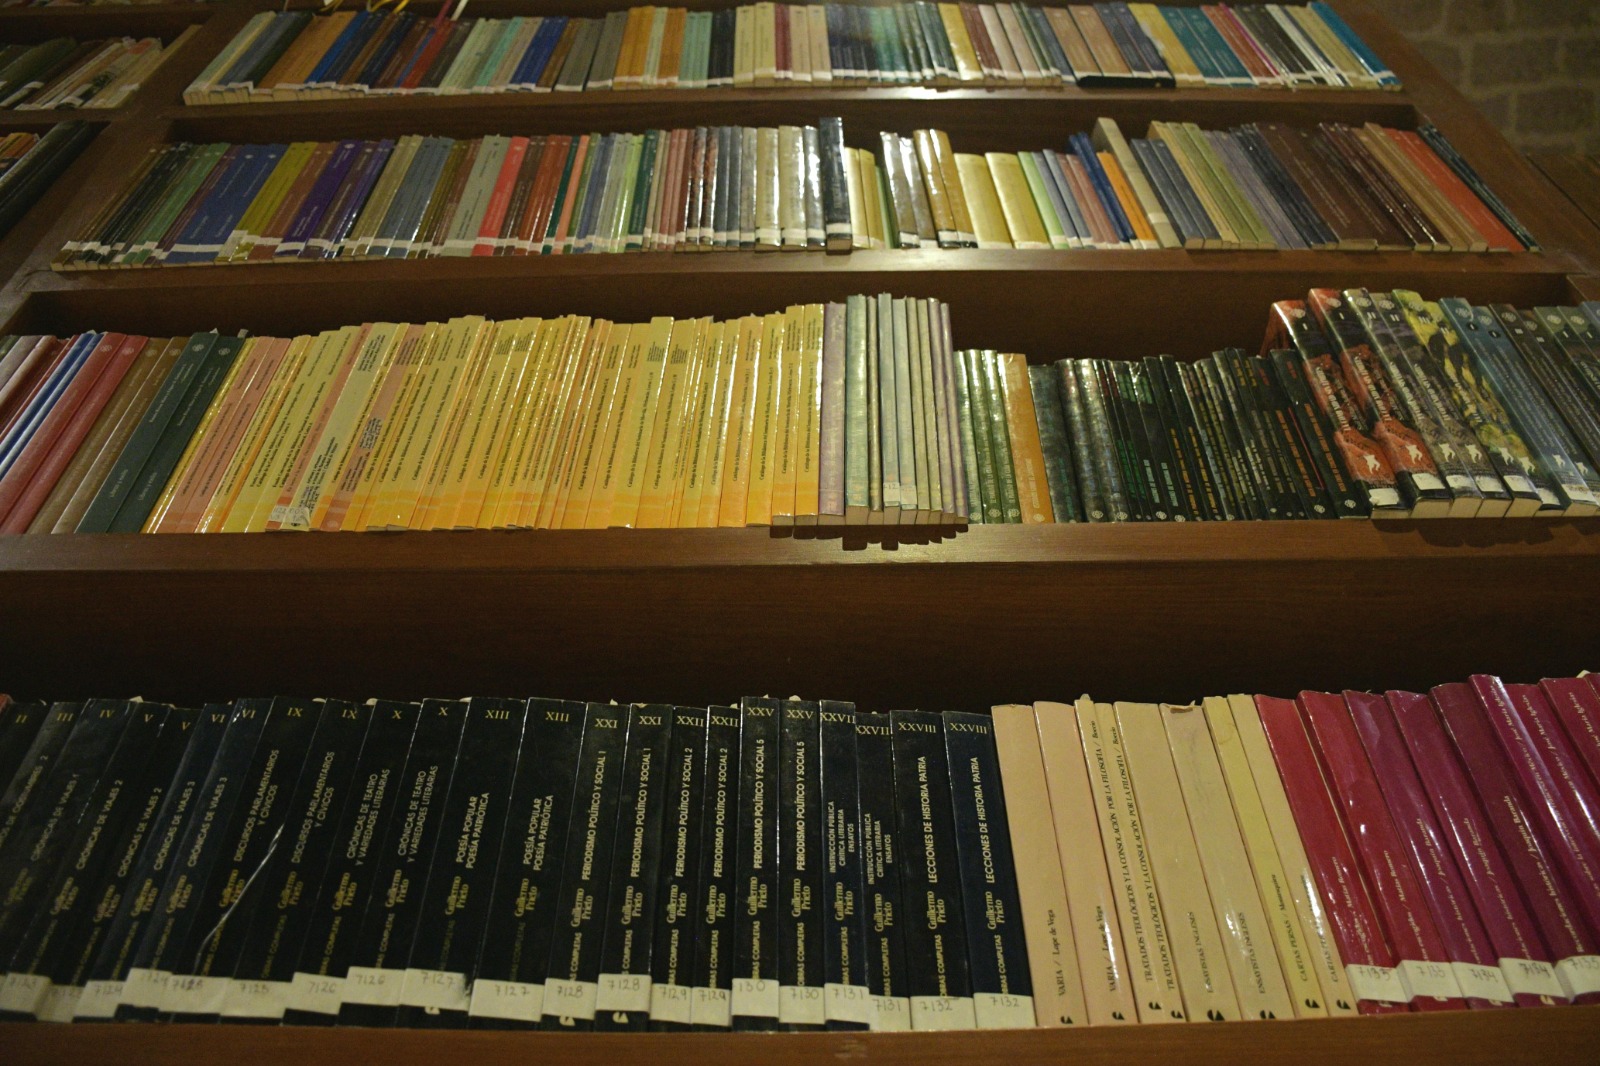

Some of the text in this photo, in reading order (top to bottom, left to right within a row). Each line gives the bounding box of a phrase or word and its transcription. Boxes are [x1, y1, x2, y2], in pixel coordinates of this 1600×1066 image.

[287, 707, 303, 716] IX
[342, 709, 358, 719] IX
[392, 710, 401, 719] X
[438, 708, 448, 716] X
[485, 710, 510, 719] XIII
[545, 712, 570, 722] XIII
[594, 719, 618, 728] XXI
[639, 716, 661, 726] XXI
[676, 716, 704, 726] XXII
[711, 716, 739, 728] XXII
[747, 707, 774, 717] XXV
[787, 709, 814, 719] XXV
[820, 712, 855, 724] XXVII
[898, 722, 937, 733] XXVIII
[950, 722, 988, 734] XXVIII
[1090, 720, 1099, 739] Boecio
[718, 754, 728, 782] SOCIAL
[755, 745, 764, 773] SOCIAL
[795, 747, 805, 775] SOCIAL
[362, 773, 378, 801] TEATRO
[412, 770, 426, 798] TEATRO
[203, 811, 215, 822] DE
[209, 783, 225, 809] VIAJES
[233, 749, 279, 862] DISCURSOS PARLAMENTARIOS
[291, 751, 334, 863] DISCURSOS PARLAMENTARIOS
[358, 810, 378, 857] VARIEDADES
[373, 769, 390, 808] LITERARIAS
[359, 803, 370, 814] DE
[408, 800, 419, 810] DE
[409, 806, 428, 854] VARIEDADES
[422, 765, 438, 805] LITERARIAS
[462, 796, 478, 832] POPULAR
[528, 798, 542, 834] POPULAR
[630, 826, 644, 877] PERIODISMO
[640, 753, 651, 781] SOCIAL
[675, 826, 687, 877] PERIODISMO
[682, 754, 692, 782] SOCIAL
[581, 829, 596, 880] PERIODISMO
[594, 756, 606, 784] SOCIAL
[837, 809, 845, 839] LITERARIA
[917, 756, 937, 883] LECCIONES DE HISTORIA PATRIA
[970, 757, 995, 883] LECCIONES DE HISTORIA PATRIA
[753, 817, 763, 869] PERIODISMO
[796, 820, 806, 870] PERIODISMO
[846, 823, 855, 853] ENSAYOS
[874, 820, 882, 850] LITERARIA
[884, 834, 892, 864] ENSAYOS
[713, 826, 724, 877] PERIODISMO
[621, 885, 634, 925] Guillermo
[631, 892, 643, 917] Prieto
[791, 878, 801, 917] Guillermo
[800, 885, 811, 910] Prieto
[985, 891, 997, 930] Guillermo
[994, 899, 1005, 923] Prieto
[873, 893, 884, 932] Guillermo
[883, 901, 893, 926] Prieto
[1047, 909, 1056, 926] Vega
[1052, 937, 1060, 955] Lope
[1284, 919, 1298, 948] PERSAS
[796, 922, 805, 987] OBRAS COMPLETAS
[1137, 936, 1152, 981] TRATADOS
[1238, 912, 1265, 994] ENSAYISTAS INGLESES
[1293, 949, 1308, 982] CARTAS
[1055, 969, 1066, 996] VARIA
